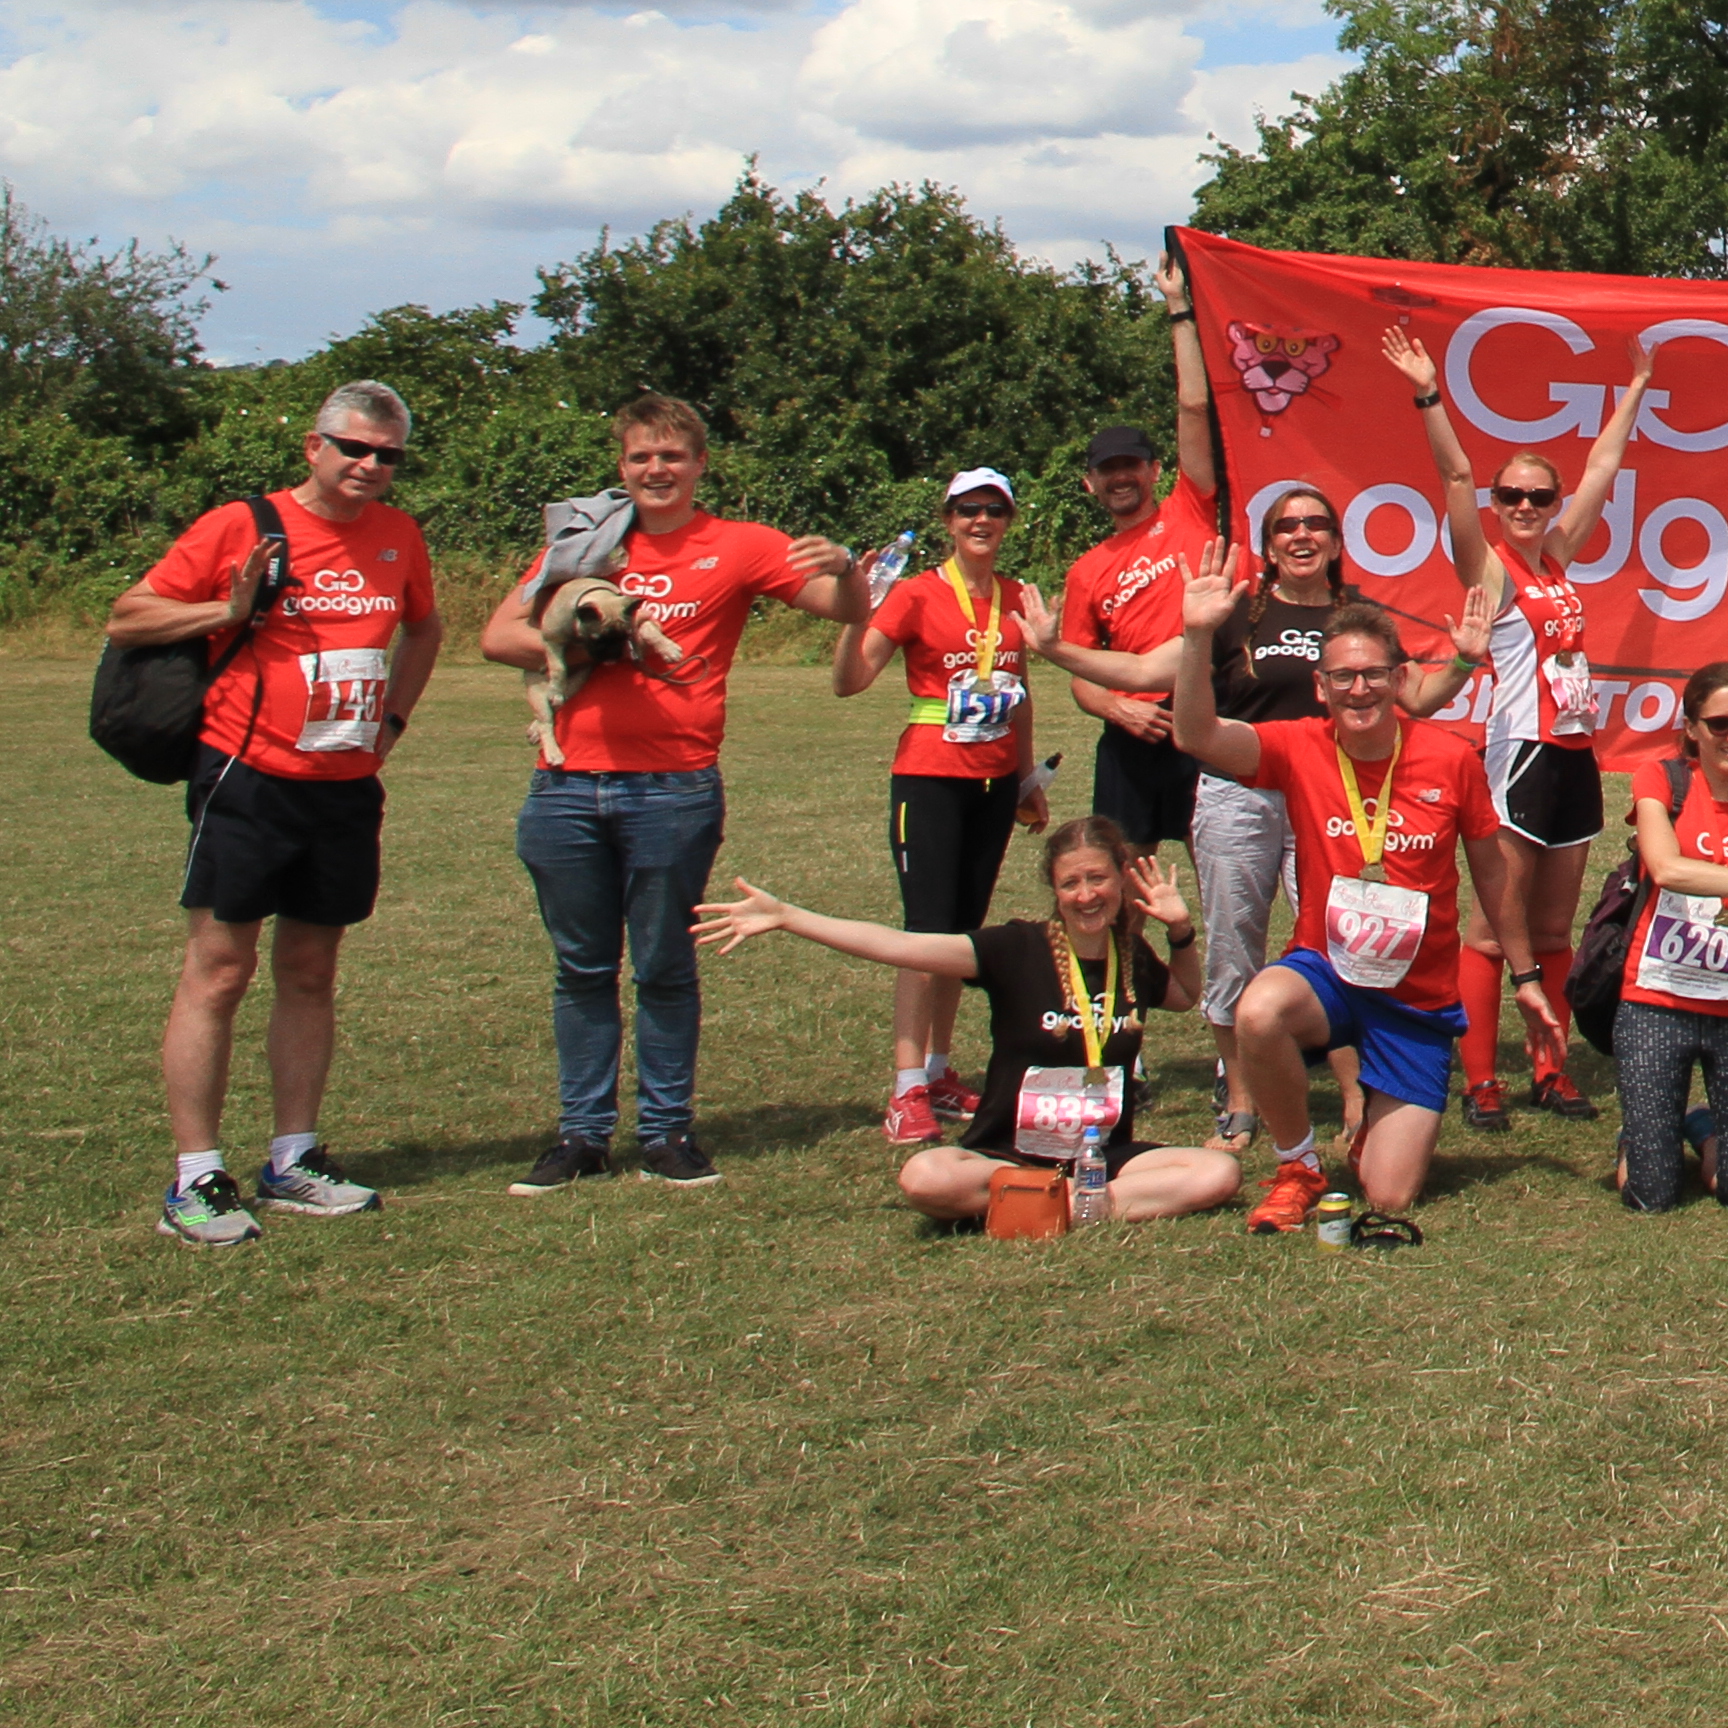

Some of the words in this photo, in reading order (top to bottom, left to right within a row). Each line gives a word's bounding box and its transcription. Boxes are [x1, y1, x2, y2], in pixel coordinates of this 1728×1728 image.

[283, 593, 397, 616] goodgym
[1254, 644, 1320, 663] goodg
[326, 680, 377, 722] 146
[1326, 817, 1437, 852] gogym
[1337, 911, 1410, 959] 927
[1033, 1094, 1106, 1133] 835
